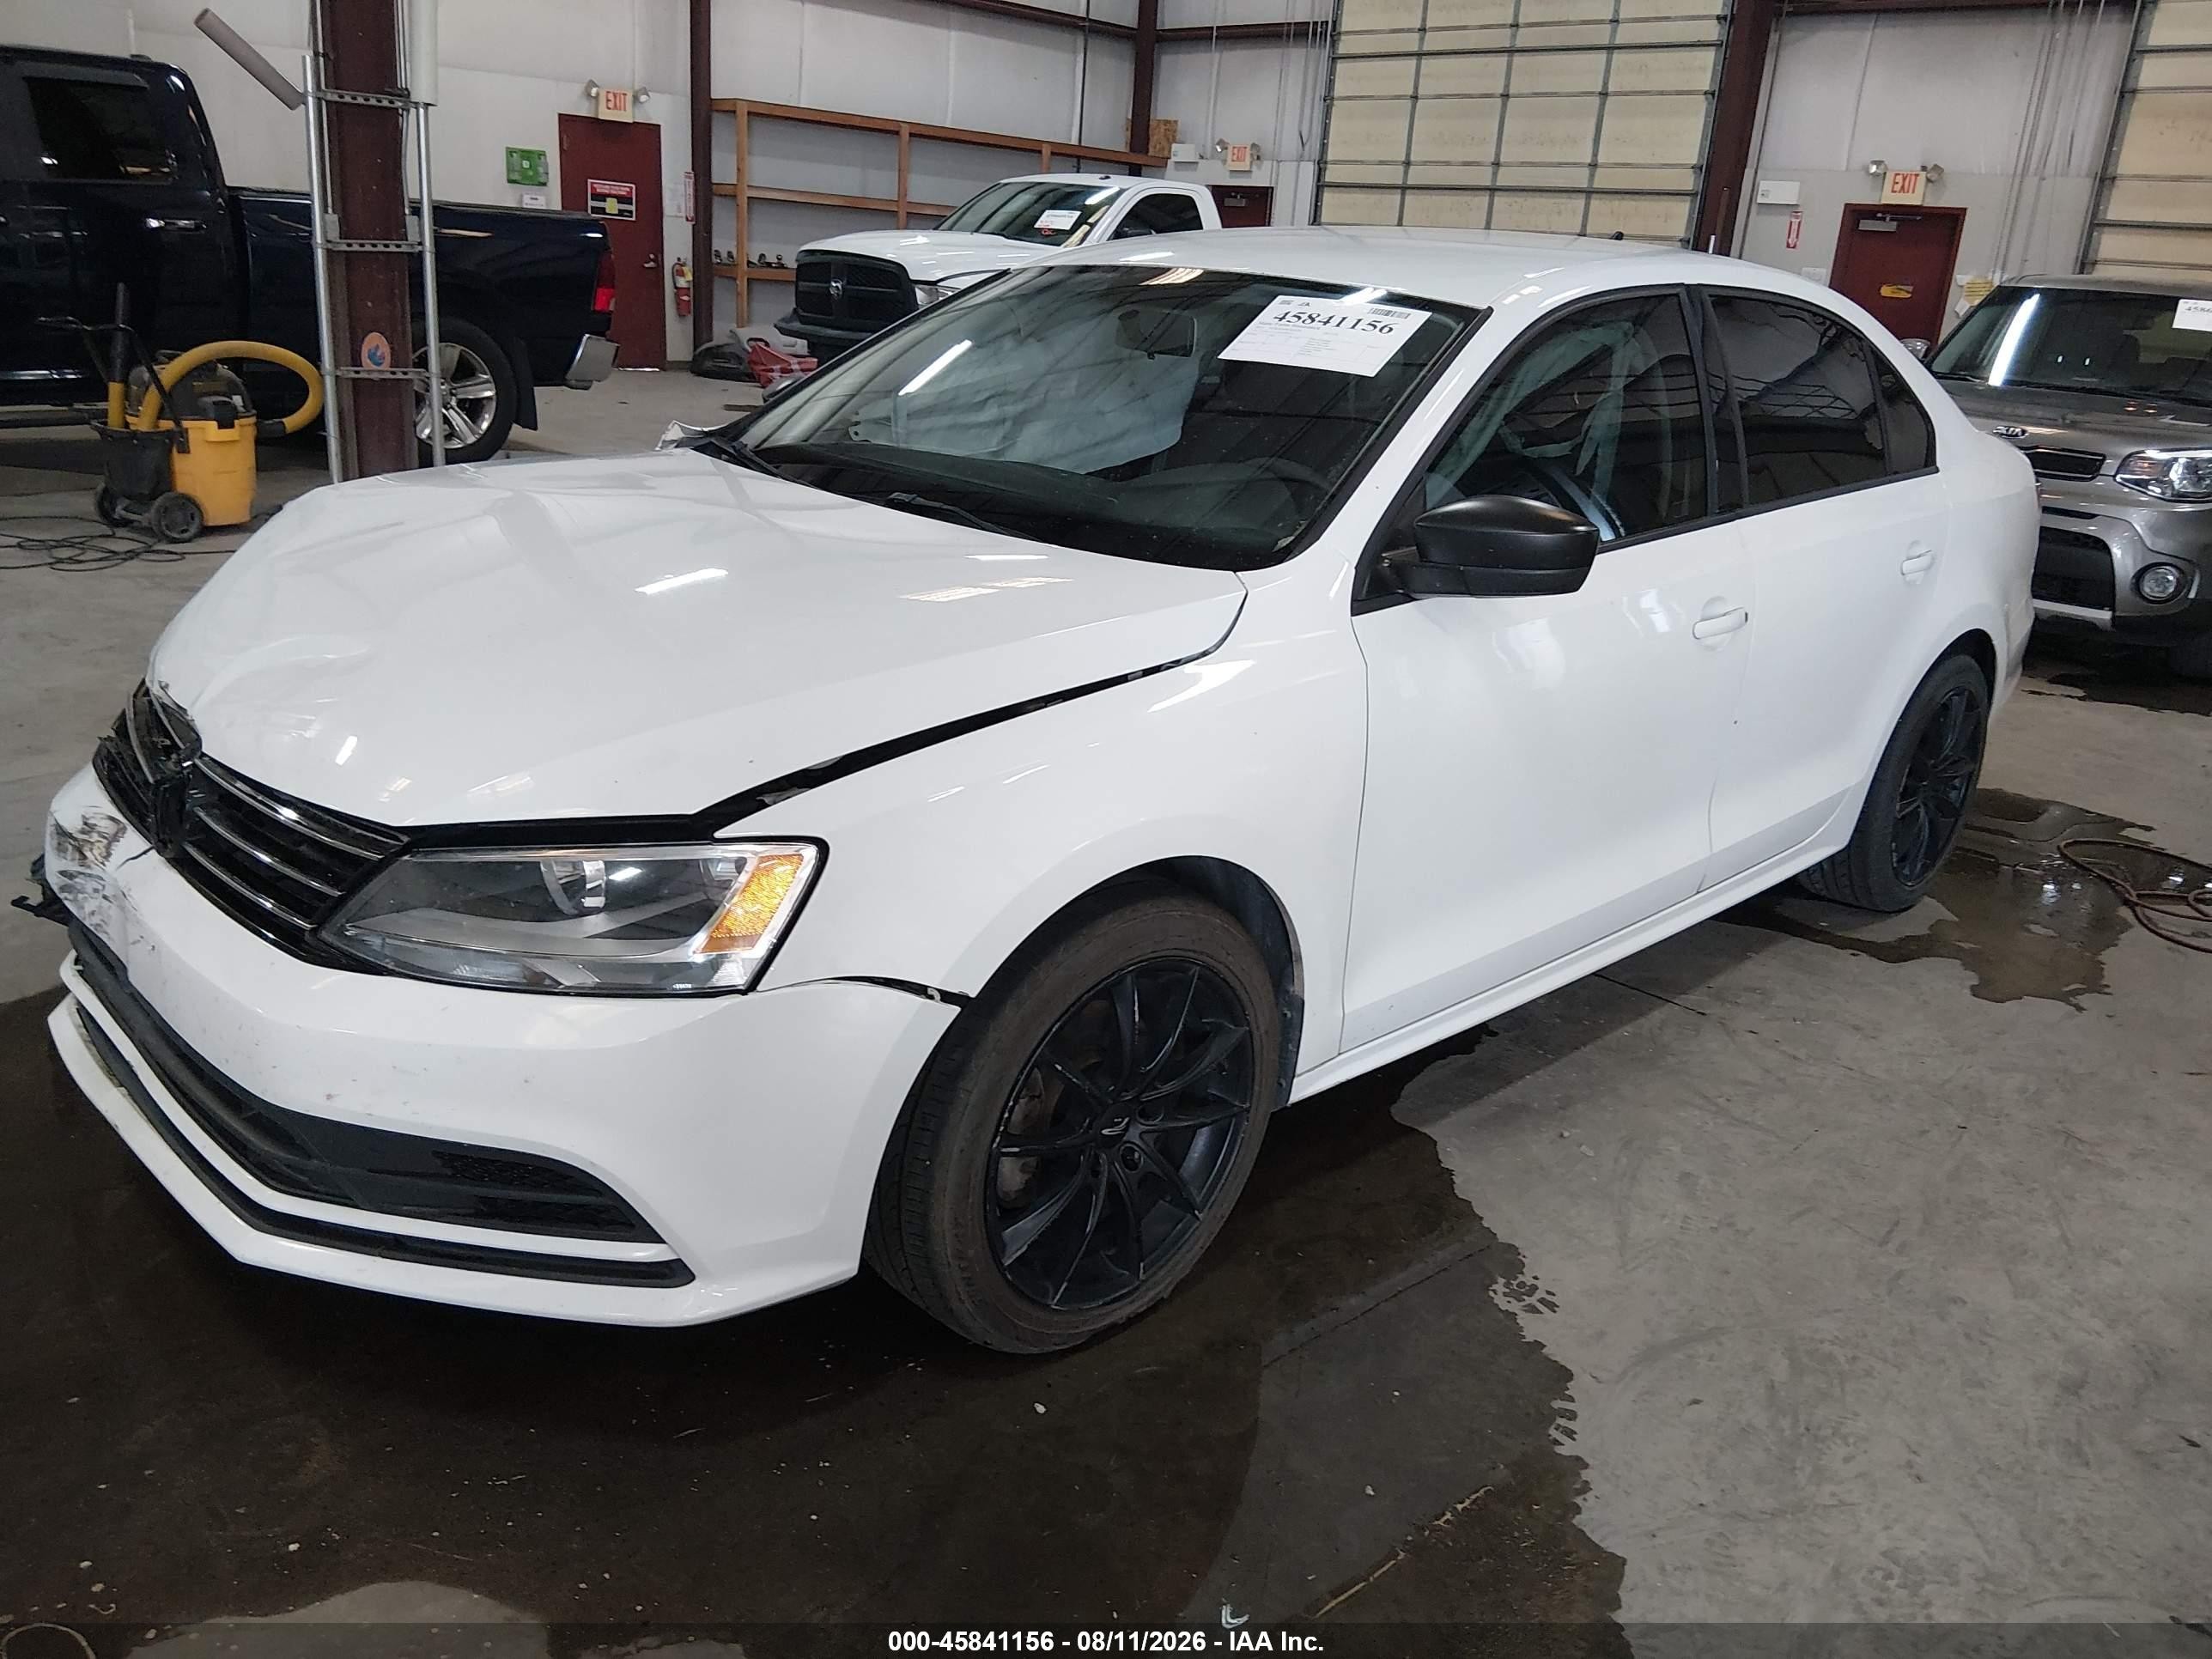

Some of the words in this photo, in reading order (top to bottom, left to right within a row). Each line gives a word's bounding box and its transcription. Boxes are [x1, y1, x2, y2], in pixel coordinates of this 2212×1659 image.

[605, 90, 628, 112] EXIT
[1891, 173, 1920, 194] EXIT
[1273, 310, 1398, 335] 45841156
